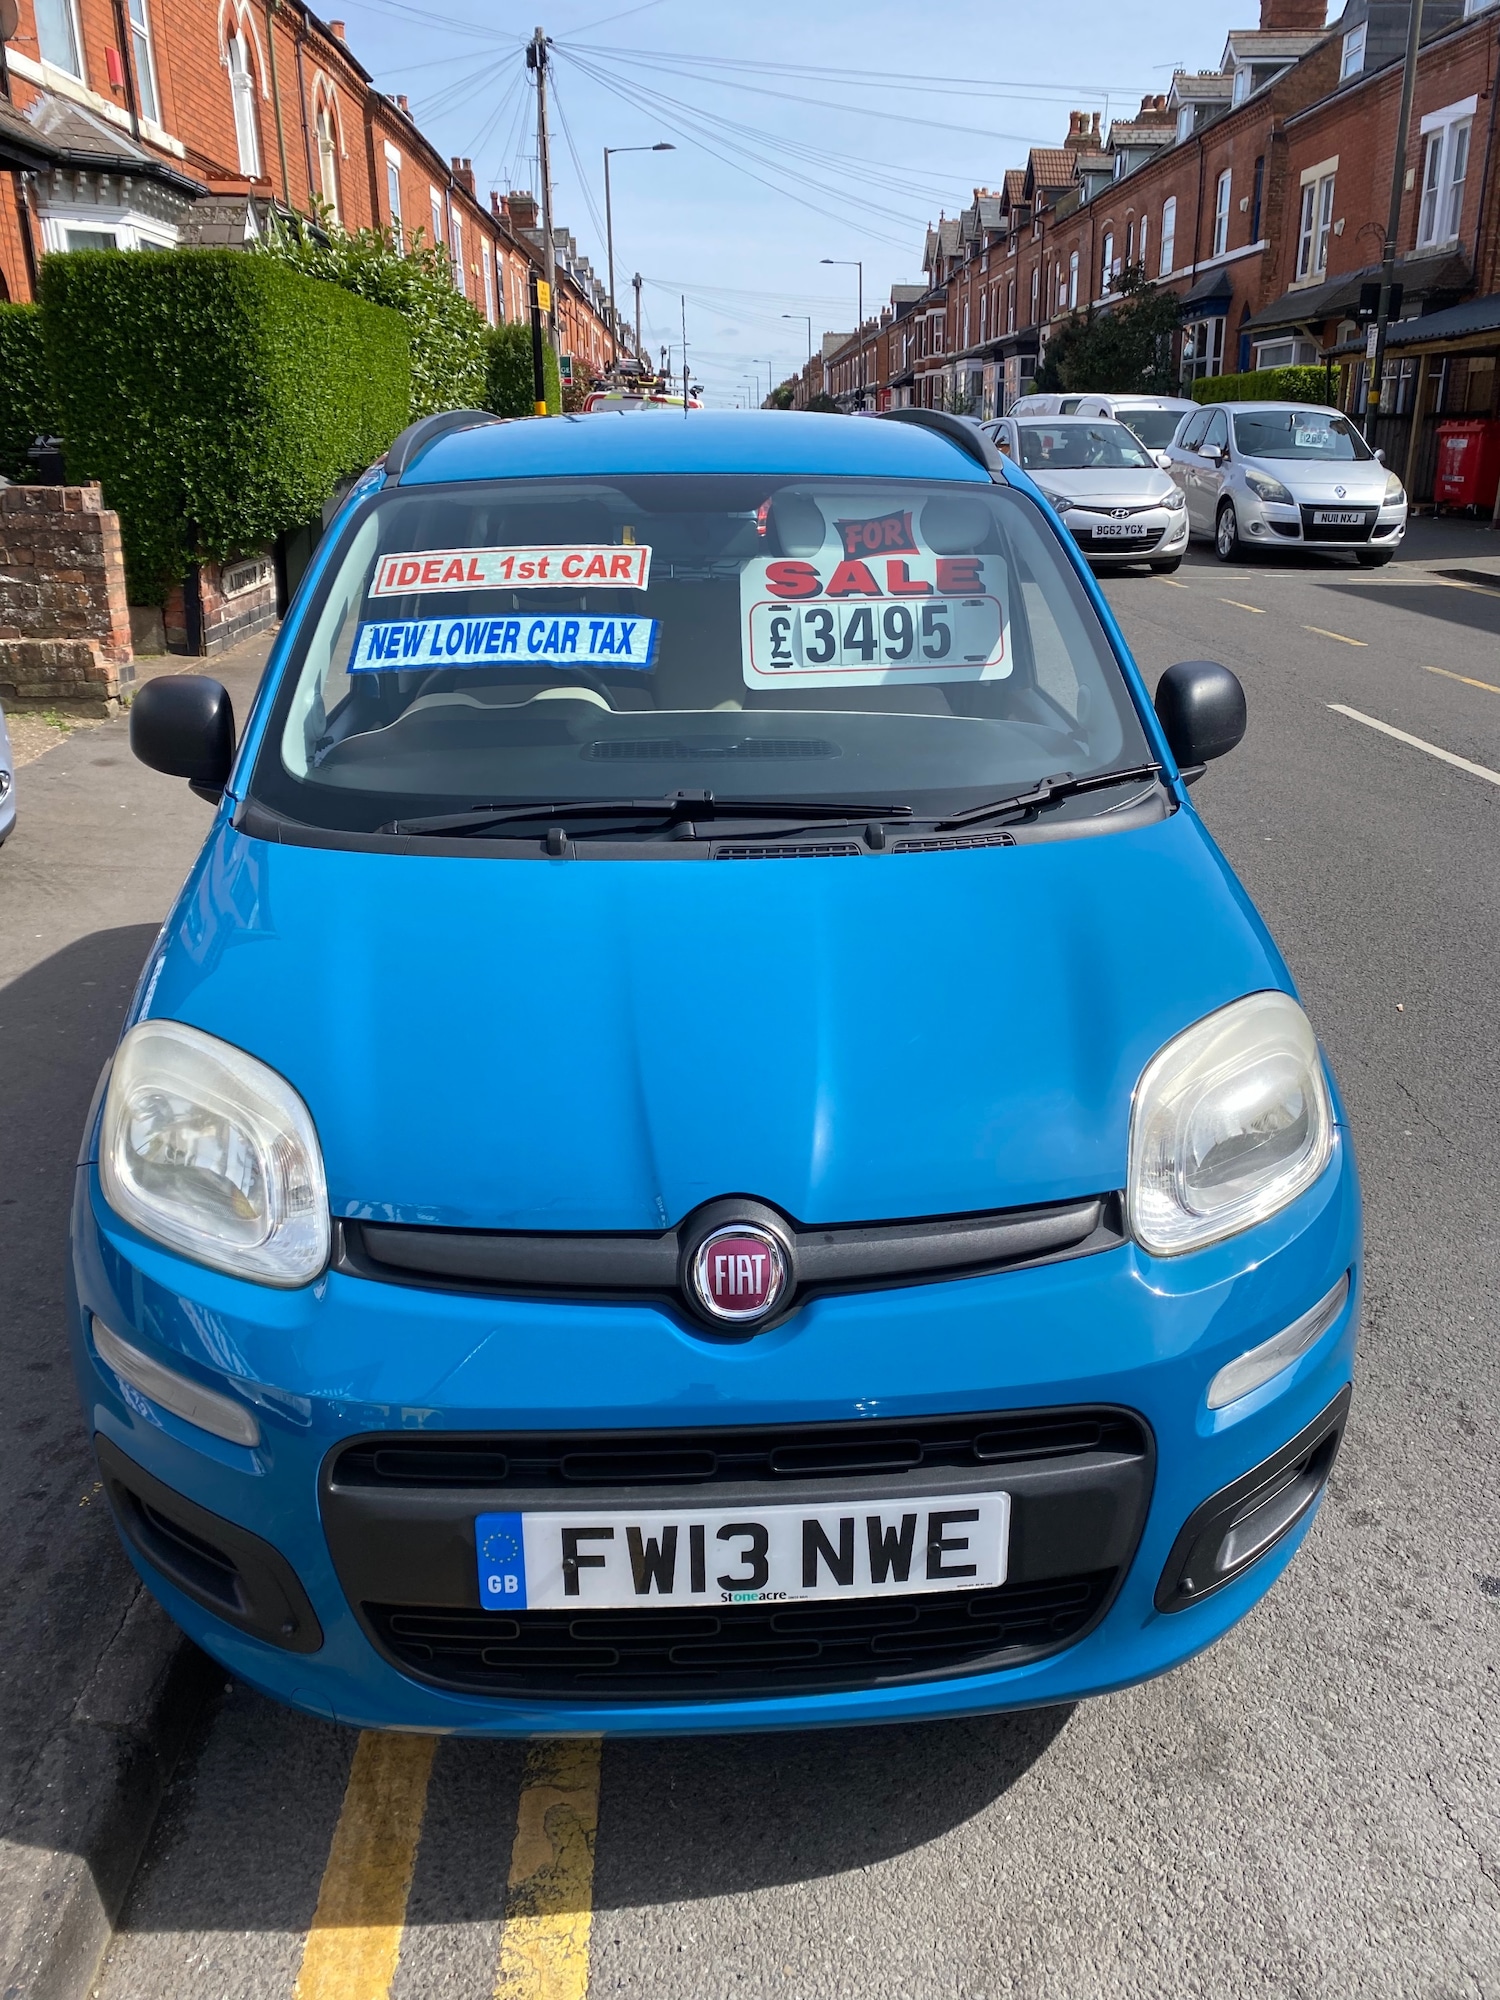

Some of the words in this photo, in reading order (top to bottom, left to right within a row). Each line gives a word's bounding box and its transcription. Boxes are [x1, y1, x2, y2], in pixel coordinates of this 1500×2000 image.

[1097, 525, 1122, 535] BG62
[1125, 524, 1143, 535] YGX
[1340, 513, 1359, 523] NXJ
[845, 519, 904, 552] FOR
[385, 557, 485, 587] IDEAL
[500, 556, 549, 580] 1st
[561, 554, 632, 579] CAR
[765, 558, 986, 599] SALE
[366, 624, 428, 661] NEW
[429, 621, 521, 655] LOWER
[527, 621, 580, 654] CAR
[588, 622, 636, 655] TAX
[770, 605, 952, 663] £3495
[715, 1254, 766, 1296] FIAT
[561, 1522, 769, 1596] FW13
[801, 1509, 979, 1588] NWE
[487, 1574, 519, 1594] GB
[720, 1591, 787, 1603] Stoneacre
